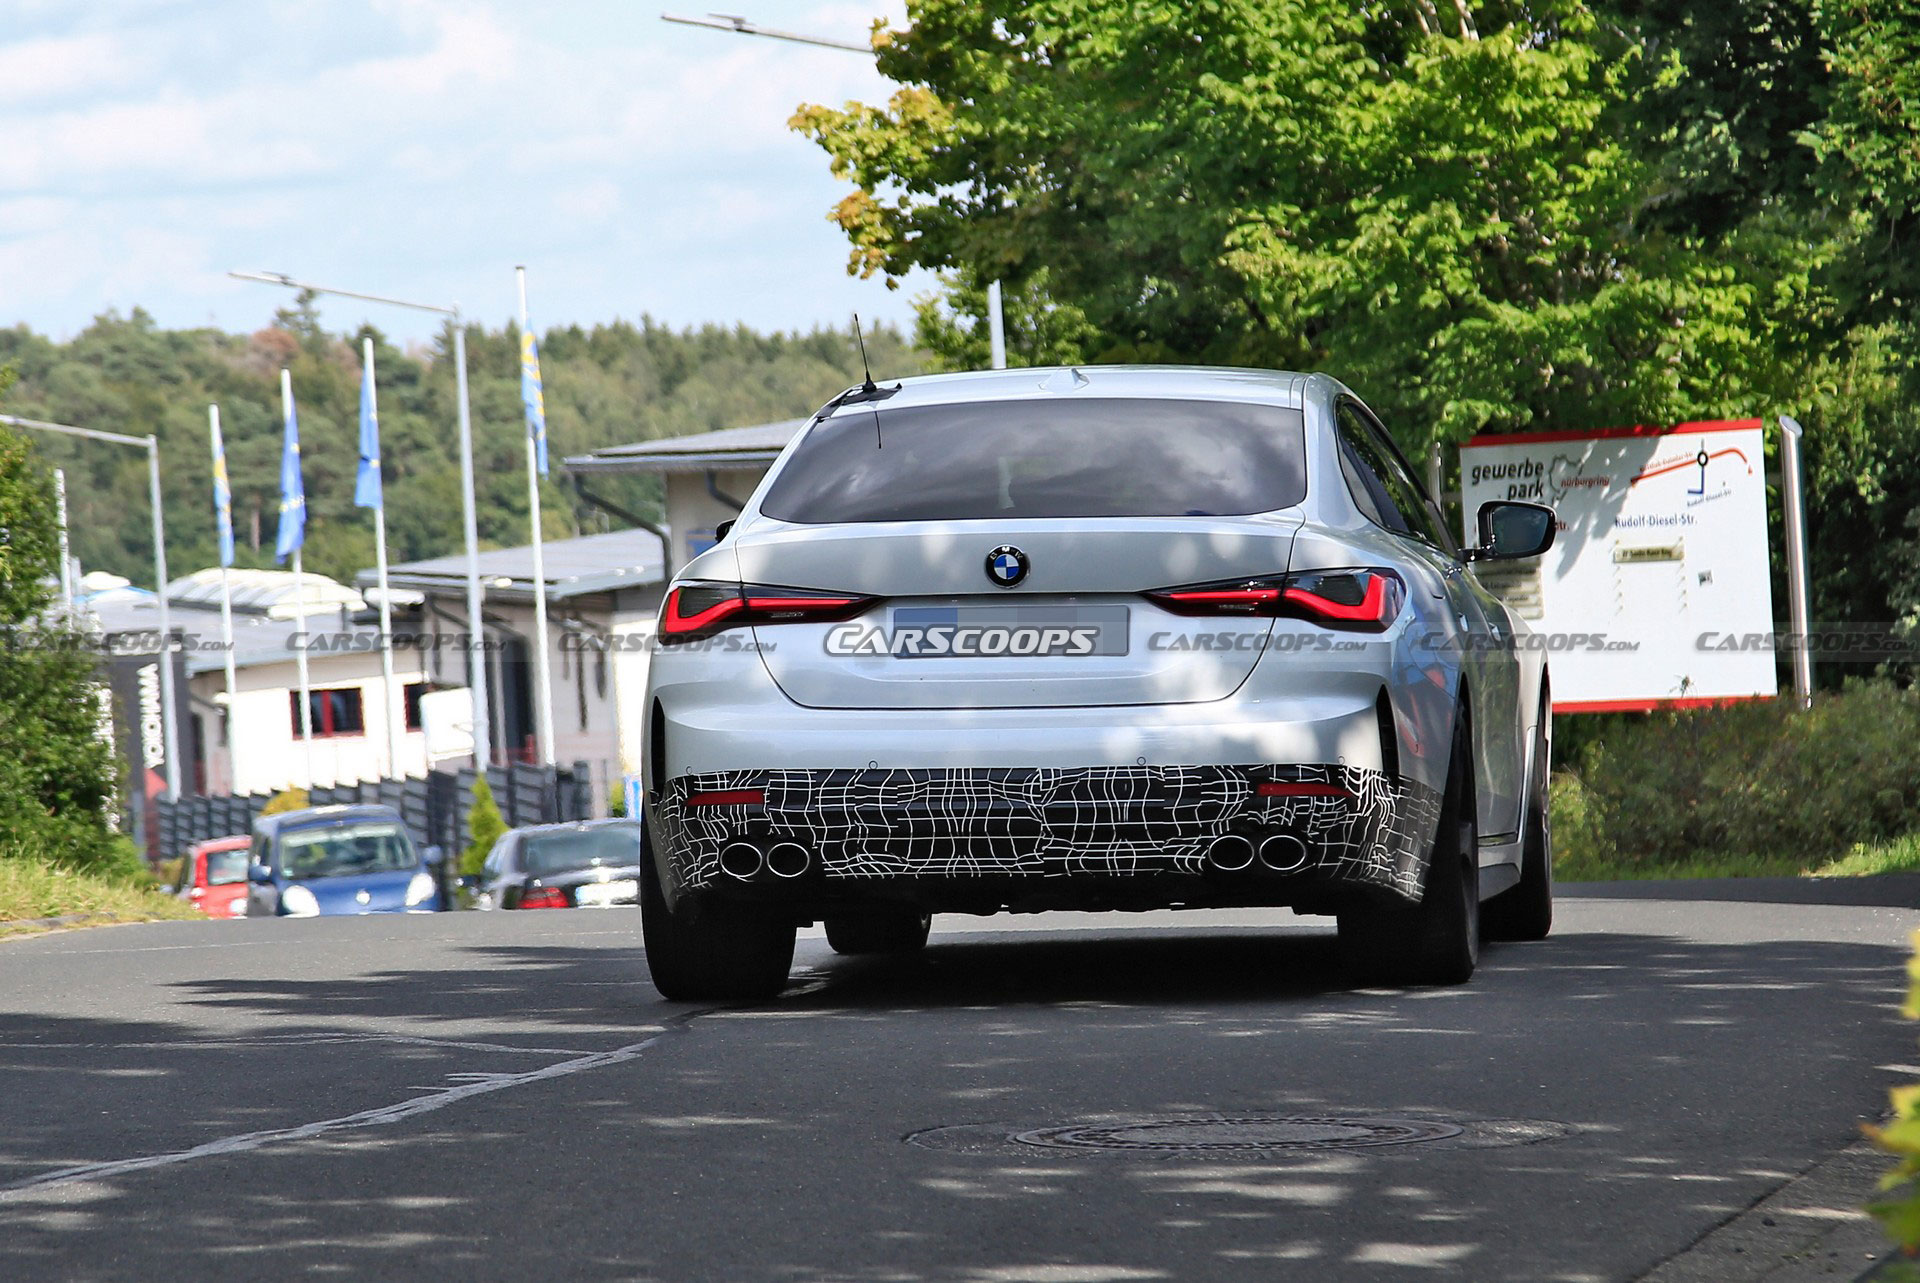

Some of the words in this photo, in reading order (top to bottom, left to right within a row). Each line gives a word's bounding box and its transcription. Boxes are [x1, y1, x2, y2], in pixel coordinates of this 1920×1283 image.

[1471, 457, 1545, 486] gewerbe
[1507, 478, 1545, 501] park
[1614, 513, 1698, 528] Rudolf-Diesel-Str.
